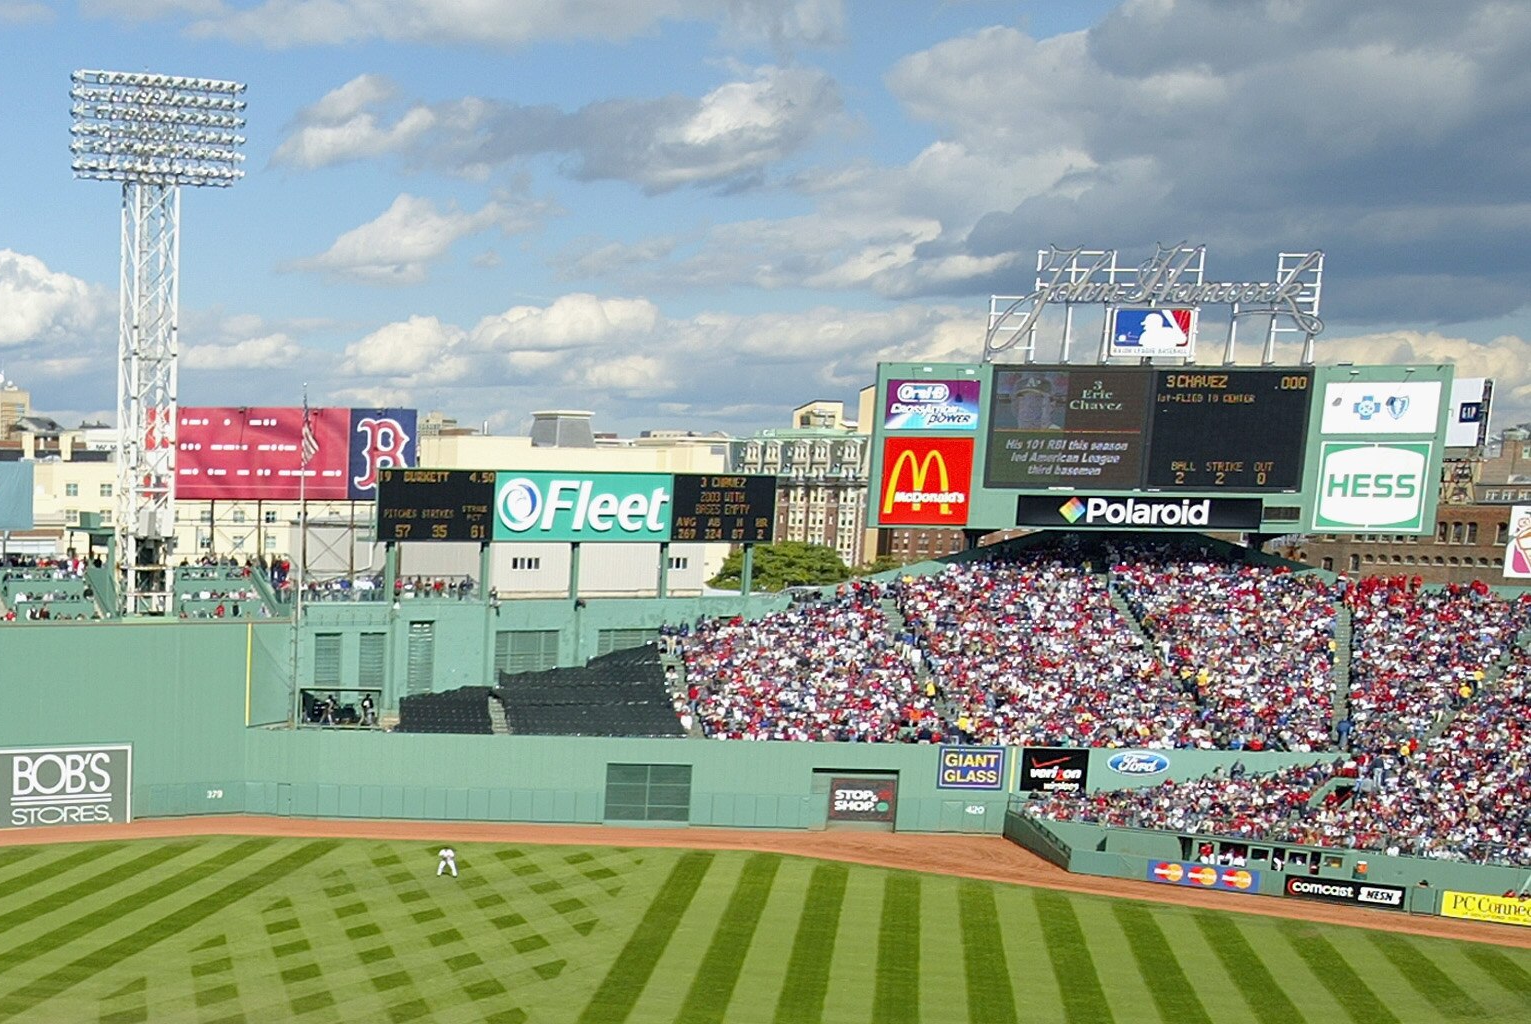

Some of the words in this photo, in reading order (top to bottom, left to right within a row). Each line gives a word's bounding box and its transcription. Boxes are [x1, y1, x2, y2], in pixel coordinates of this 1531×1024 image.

[986, 243, 1118, 352] John
[1125, 240, 1324, 334] Hancock
[1166, 375, 1176, 388] 3
[1177, 375, 1229, 389] CHAVEZ
[1274, 376, 1308, 390] .000
[900, 386, 946, 400] Oral-B
[1081, 389, 1113, 399] Eric
[1069, 399, 1123, 411] Chavez
[1006, 439, 1022, 450] His
[1026, 439, 1045, 450] 101
[1047, 439, 1067, 450] RBI
[1068, 439, 1088, 451] this
[1090, 441, 1128, 451] season
[1011, 452, 1027, 462] led
[1029, 452, 1078, 463] American
[1081, 453, 1120, 466] League
[1027, 464, 1052, 475] third
[1054, 464, 1102, 475] basemen
[1171, 461, 1196, 472] BALL
[1206, 461, 1243, 472] STRIKE
[1253, 461, 1274, 472] OUT
[379, 471, 391, 483] 19
[404, 471, 450, 483] BURKETT
[469, 472, 495, 483] 4.50
[700, 477, 707, 488] 3
[1175, 472, 1184, 485] 2
[1215, 472, 1225, 485] 2
[1257, 472, 1266, 485] 0
[1327, 474, 1415, 498] HESS
[700, 491, 721, 502] 2003
[724, 491, 746, 502] WITH
[893, 491, 965, 503] McDonald's
[540, 480, 670, 532] Fleet
[695, 504, 721, 515] BASES
[724, 504, 751, 515] EMPTY
[1086, 498, 1210, 525] Polaroid
[676, 517, 697, 527] AVG
[707, 517, 721, 527] AB
[394, 524, 412, 538] 57
[431, 524, 448, 538] 35
[470, 525, 485, 539] 61
[756, 529, 764, 539] 2
[944, 754, 998, 767] GIANT
[1118, 753, 1158, 773] Ford
[13, 752, 111, 796] BOB'S
[943, 769, 998, 783] GLASS
[1029, 766, 1082, 781] verizon
[965, 805, 985, 815] 420
[1293, 877, 1354, 897] comcast
[1366, 890, 1394, 902] NESN
[1453, 894, 1476, 912] PC
